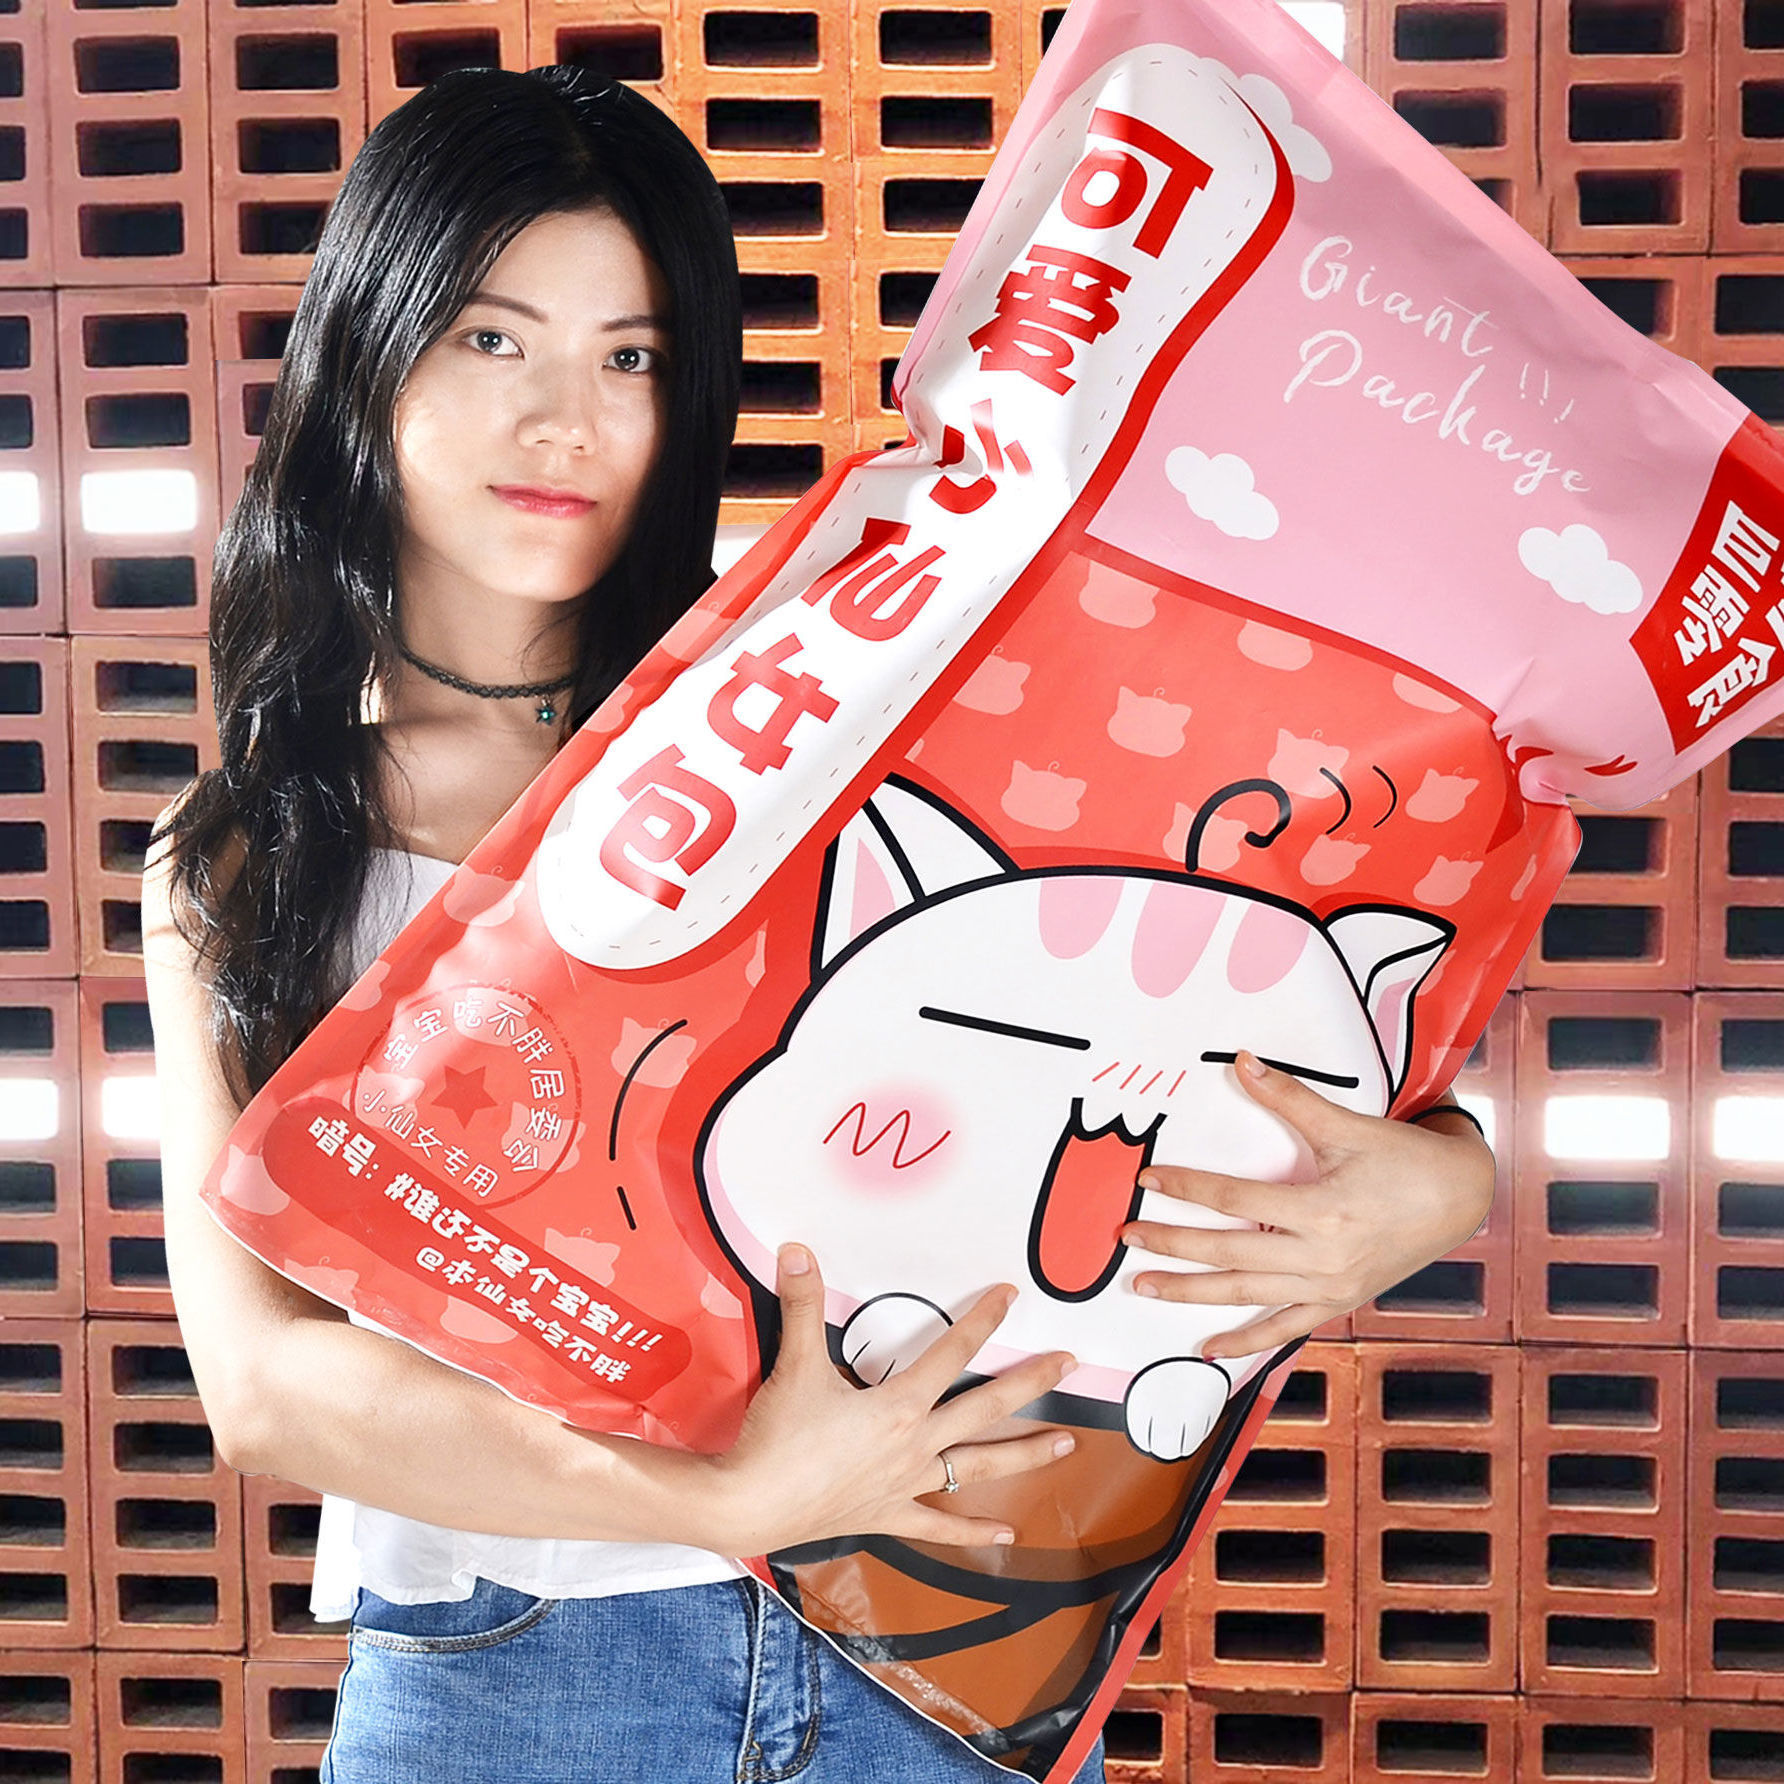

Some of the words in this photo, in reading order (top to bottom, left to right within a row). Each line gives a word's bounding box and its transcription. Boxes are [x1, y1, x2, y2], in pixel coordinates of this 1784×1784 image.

[1299, 235, 1499, 357] Giant
[1283, 329, 1593, 496] Package
[599, 108, 1214, 911] 可爱小仙女包
[363, 1089, 499, 1197] 小仙女专用
[383, 997, 565, 1172] 宝宝吃不胖居委会
[415, 1247, 633, 1384] @本仙女吃不胖
